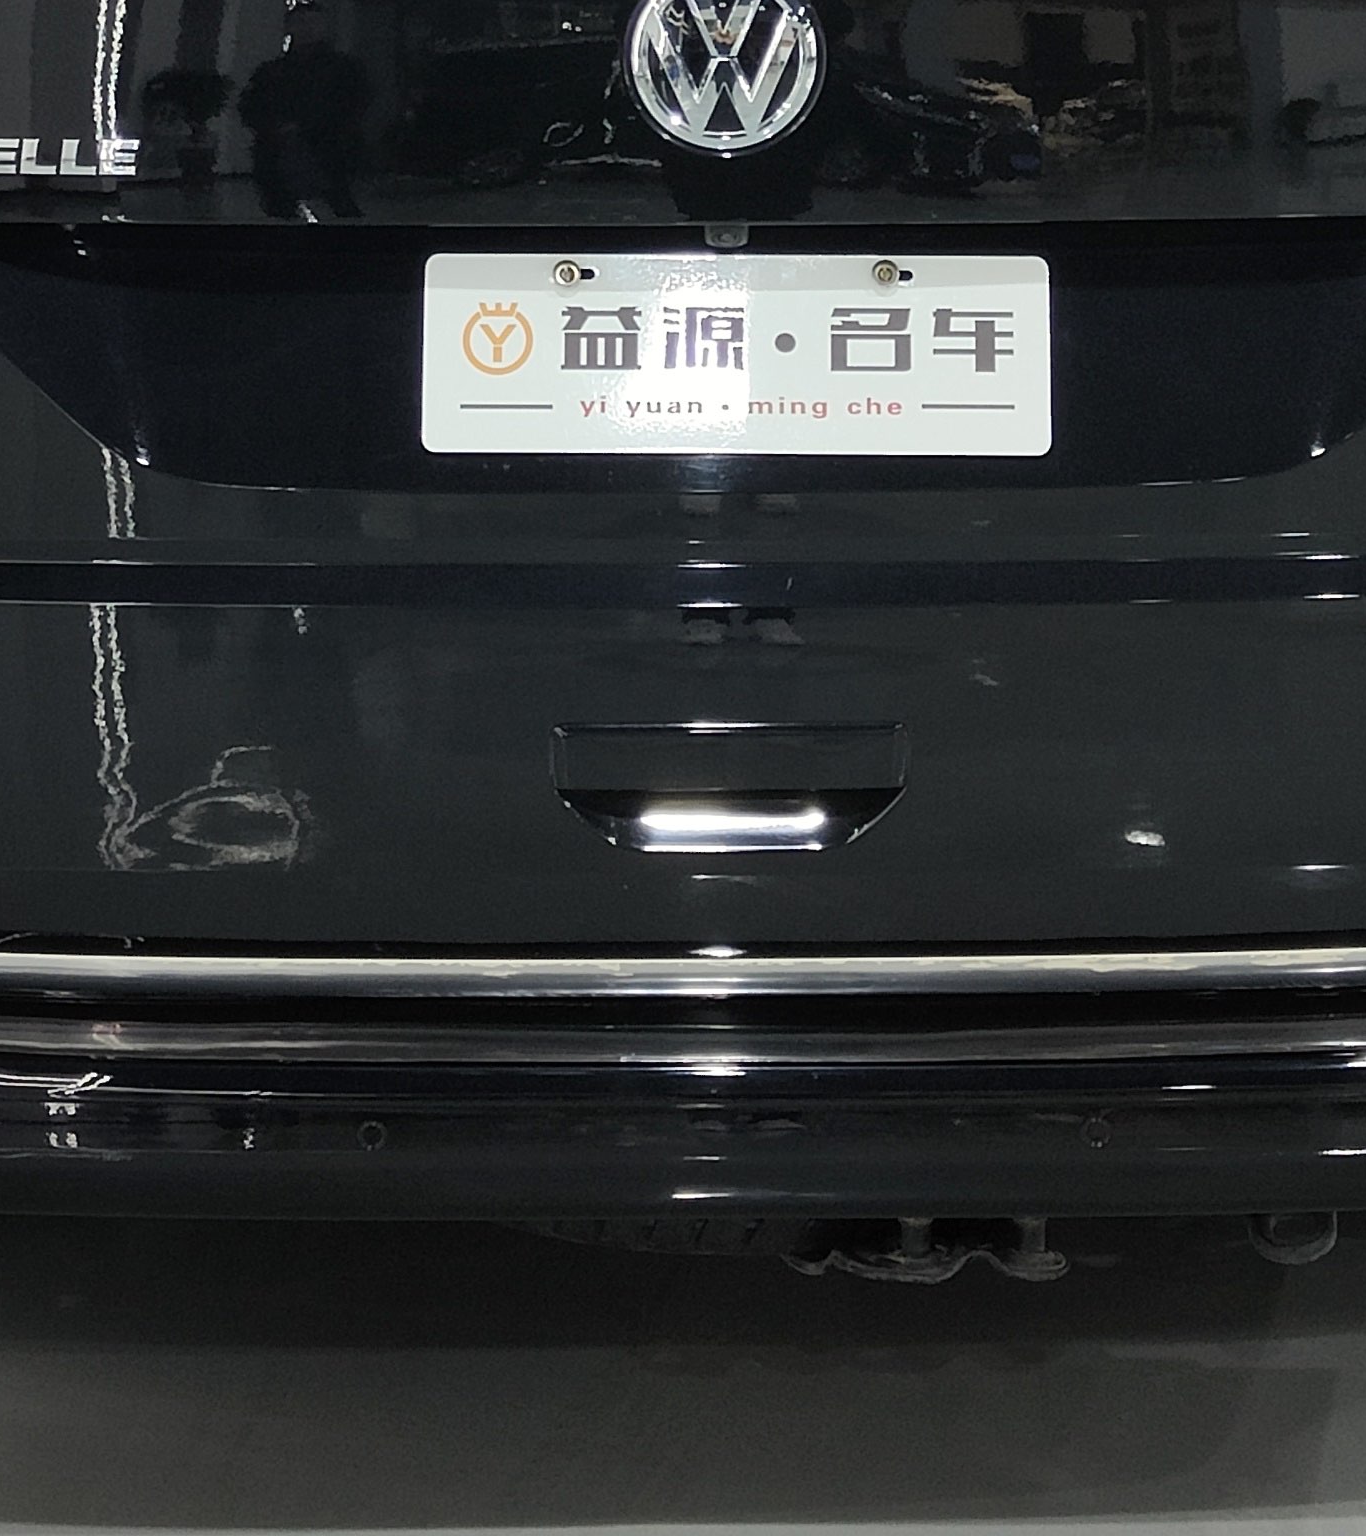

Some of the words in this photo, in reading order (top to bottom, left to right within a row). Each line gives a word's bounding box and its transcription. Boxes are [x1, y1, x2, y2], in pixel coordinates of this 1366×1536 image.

[580, 396, 607, 417] yi
[626, 401, 703, 417] yuan
[748, 397, 828, 419] ming
[847, 397, 903, 415] che
